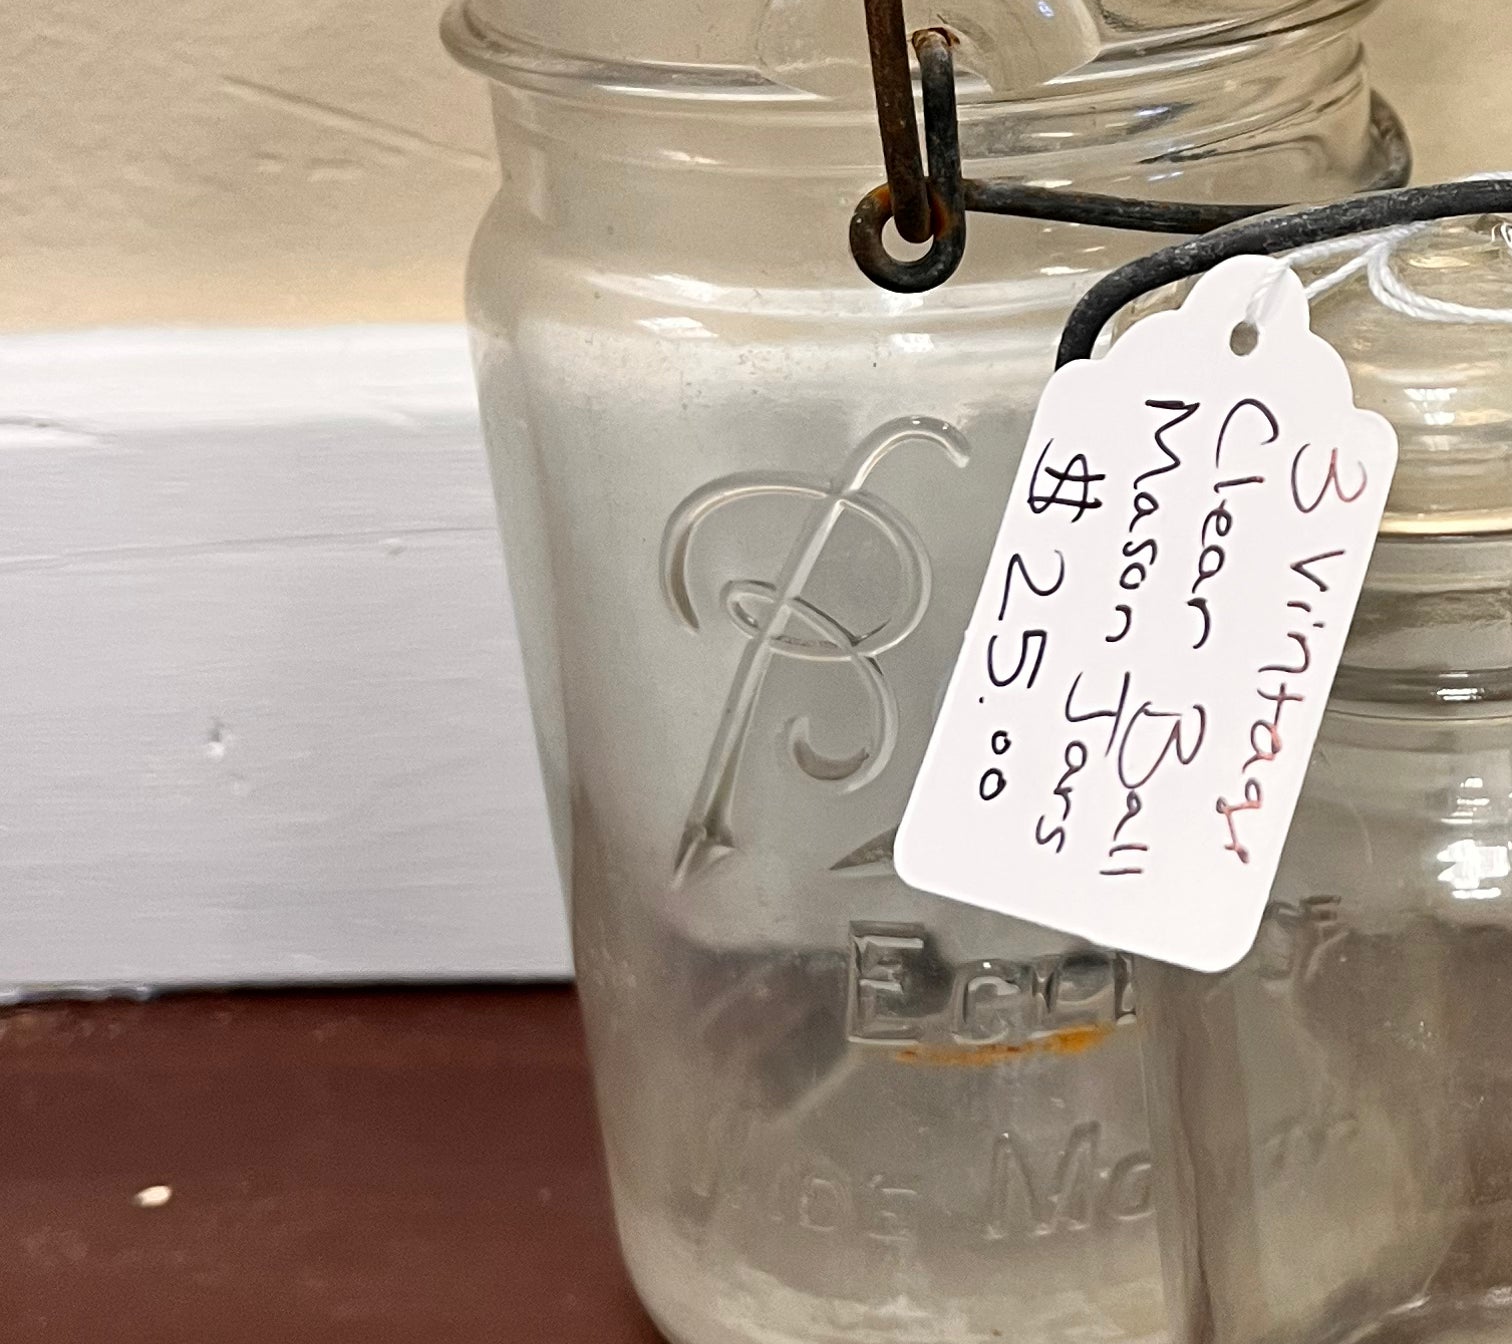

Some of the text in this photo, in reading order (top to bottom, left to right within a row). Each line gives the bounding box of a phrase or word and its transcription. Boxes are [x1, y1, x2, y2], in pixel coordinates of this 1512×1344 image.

[1035, 399, 1201, 854] Mason Jars
[1100, 398, 1279, 875] Clear Ball
[1290, 443, 1367, 513] 3
